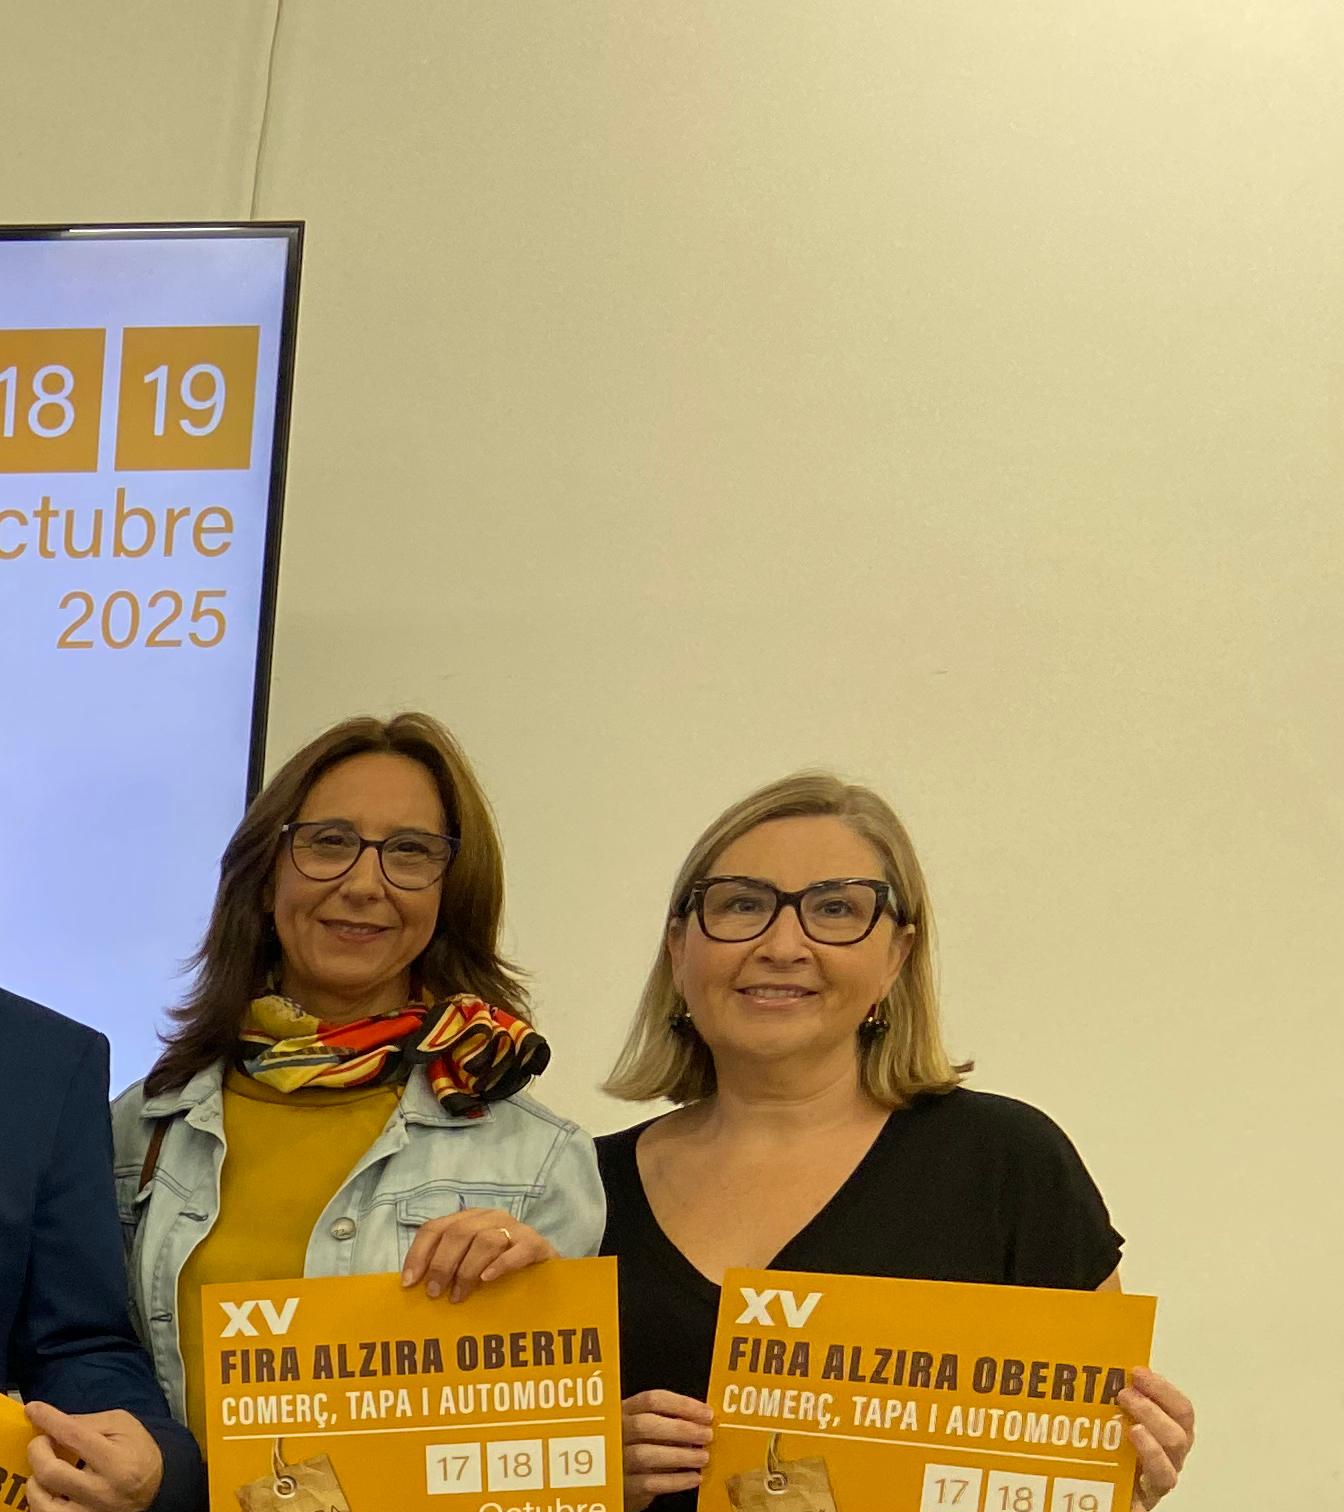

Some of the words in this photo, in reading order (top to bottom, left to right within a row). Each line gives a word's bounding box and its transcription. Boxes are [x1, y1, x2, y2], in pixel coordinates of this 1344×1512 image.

[144, 364, 226, 436] 19
[57, 589, 226, 650] 2025
[220, 1297, 299, 1338] XV
[735, 1287, 823, 1328] XV
[220, 1345, 299, 1384] FIRA
[313, 1338, 442, 1380] ALZIRA
[456, 1328, 602, 1371] OBERTA
[728, 1337, 810, 1378] FIRA
[822, 1344, 958, 1391] ALZIRA
[222, 1391, 338, 1429] COMERÇ,
[346, 1388, 412, 1420] TAPA
[422, 1389, 428, 1416] I
[440, 1370, 604, 1415] AUTOMOCIÓ
[722, 1384, 840, 1431] COMERÇ,
[851, 1396, 918, 1432] TAPA
[928, 1403, 938, 1434] I
[946, 1405, 1122, 1451] AUTOMOCIÓ
[437, 1457, 470, 1481] 17
[499, 1453, 532, 1478] 18
[559, 1450, 592, 1475] 19
[934, 1478, 969, 1506] 17
[998, 1484, 1033, 1512] 18
